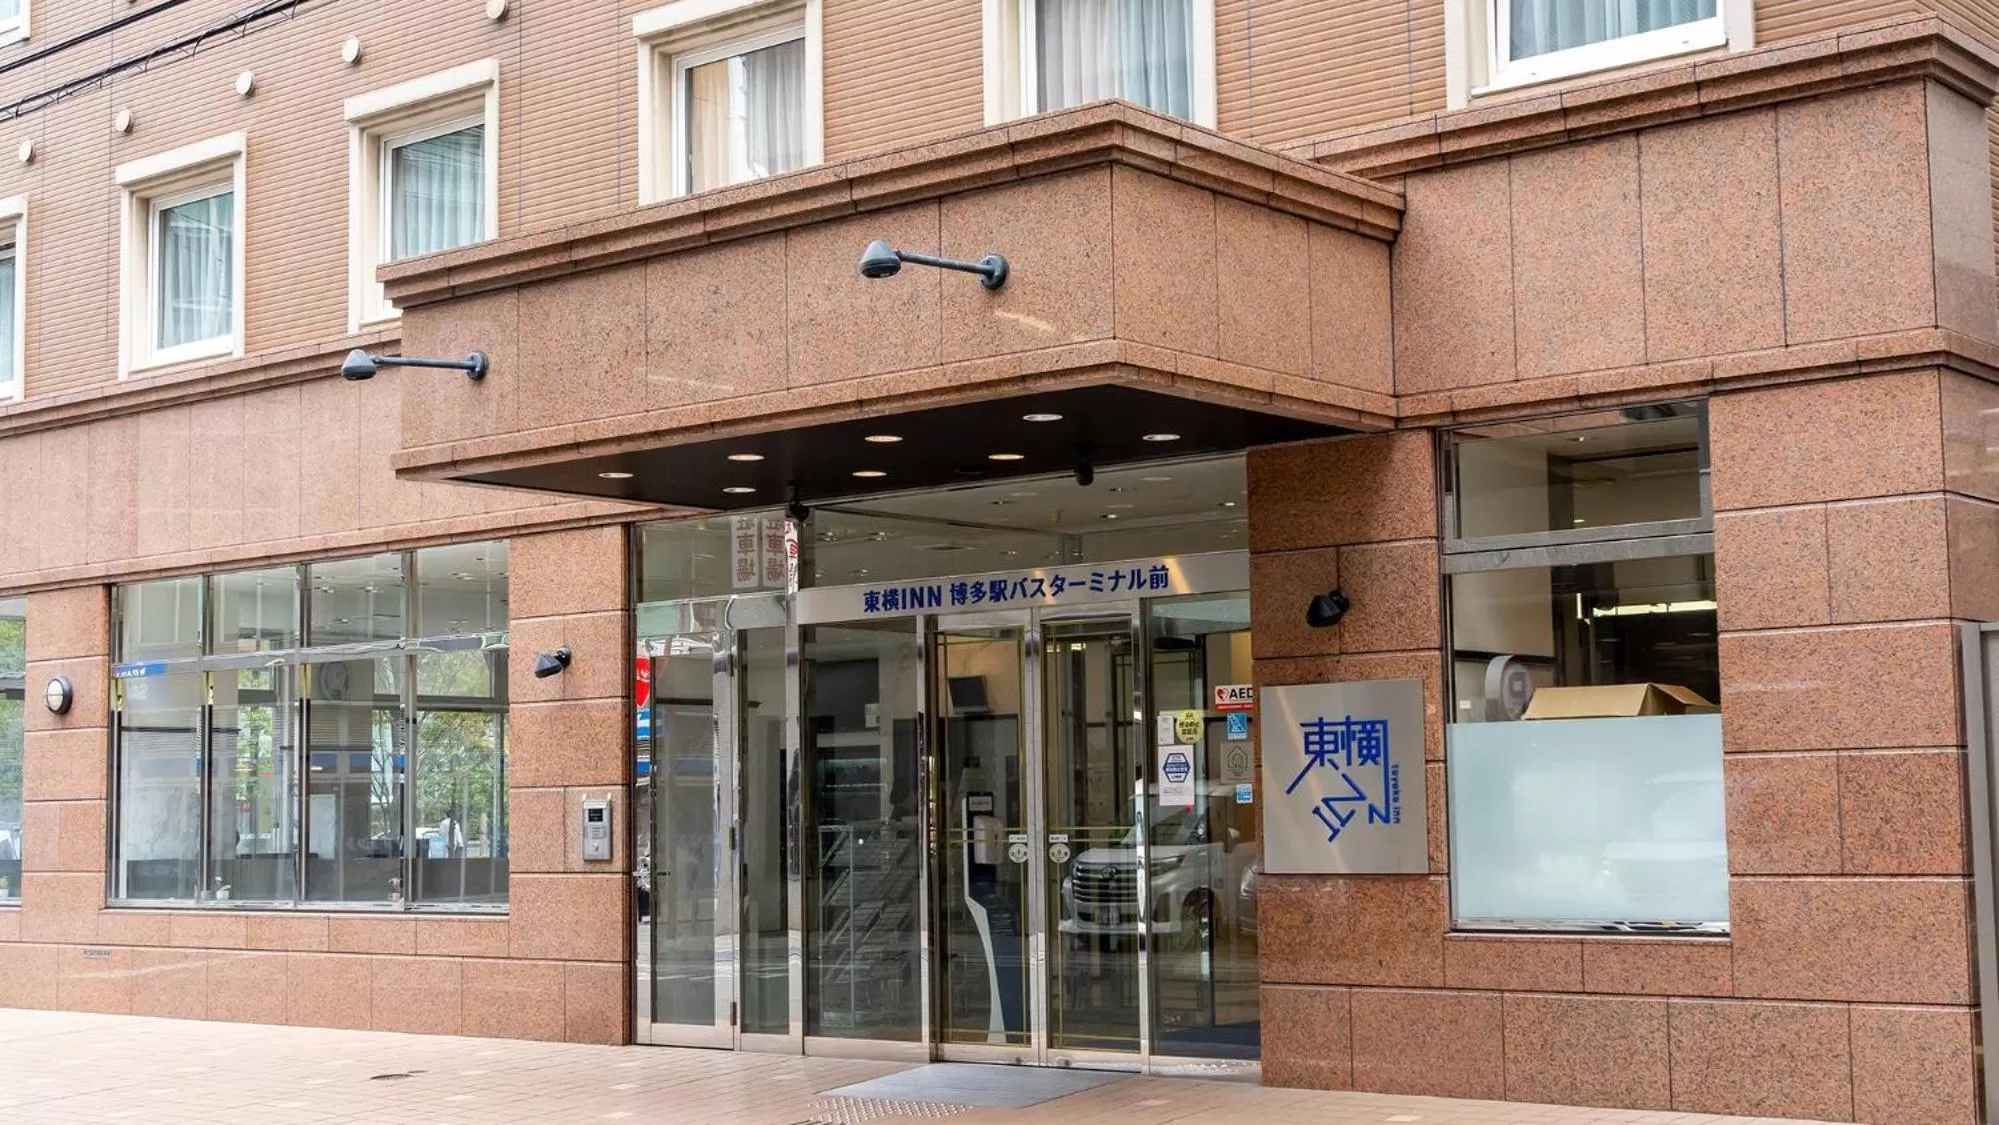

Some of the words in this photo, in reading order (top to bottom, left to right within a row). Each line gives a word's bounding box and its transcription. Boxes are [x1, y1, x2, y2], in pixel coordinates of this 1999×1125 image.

[863, 585, 942, 613] 東横INN
[949, 564, 1170, 607] 博多駅バスターミナル前
